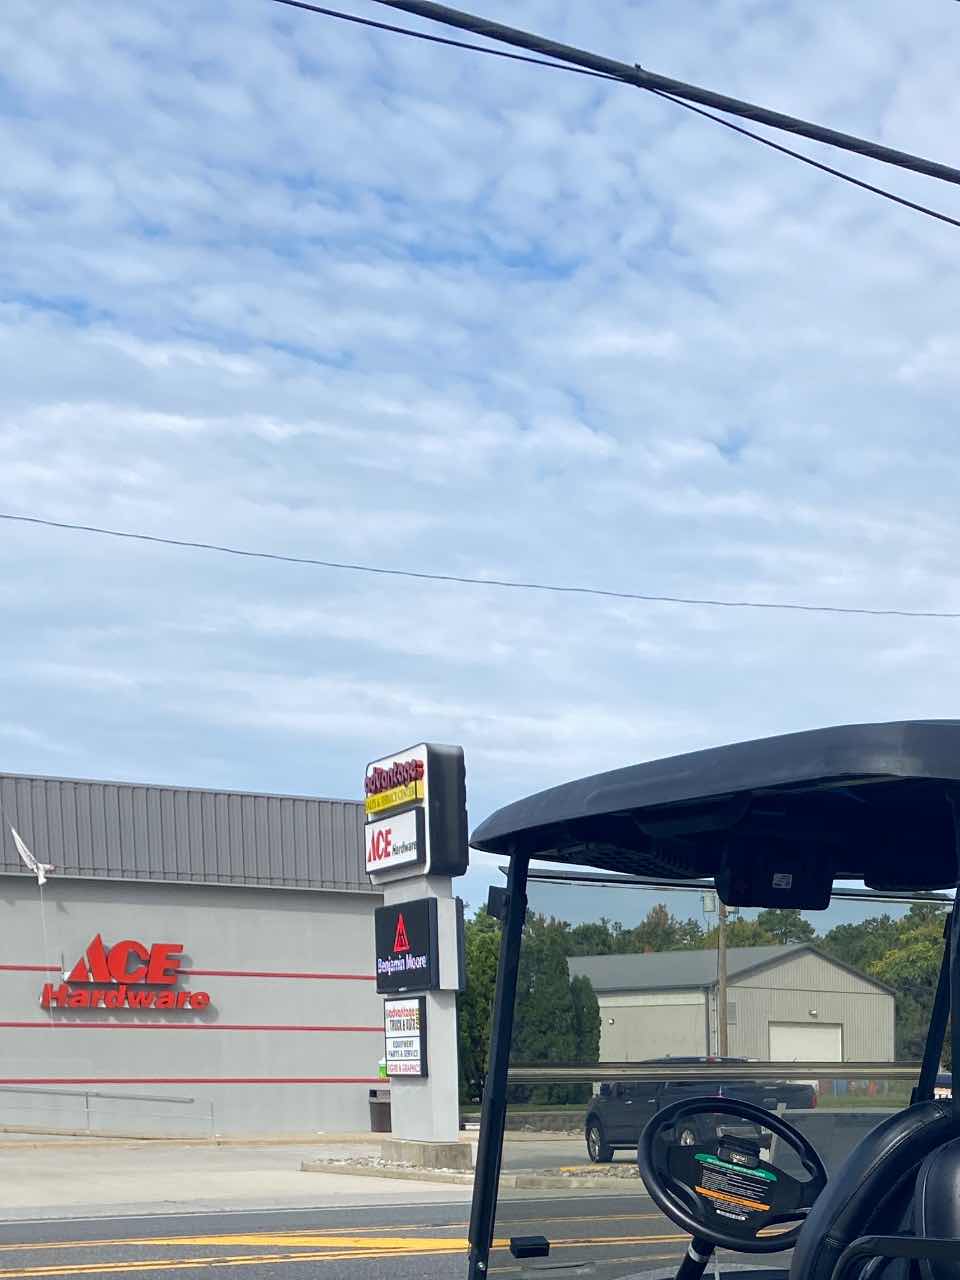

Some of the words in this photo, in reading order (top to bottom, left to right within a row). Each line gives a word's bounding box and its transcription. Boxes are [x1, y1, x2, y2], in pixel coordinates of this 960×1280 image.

[367, 828, 392, 862] ACE
[66, 933, 184, 984] ACE
[377, 956, 405, 976] Benjamin
[405, 954, 427, 969] Moore
[40, 983, 211, 1010] Hardware
